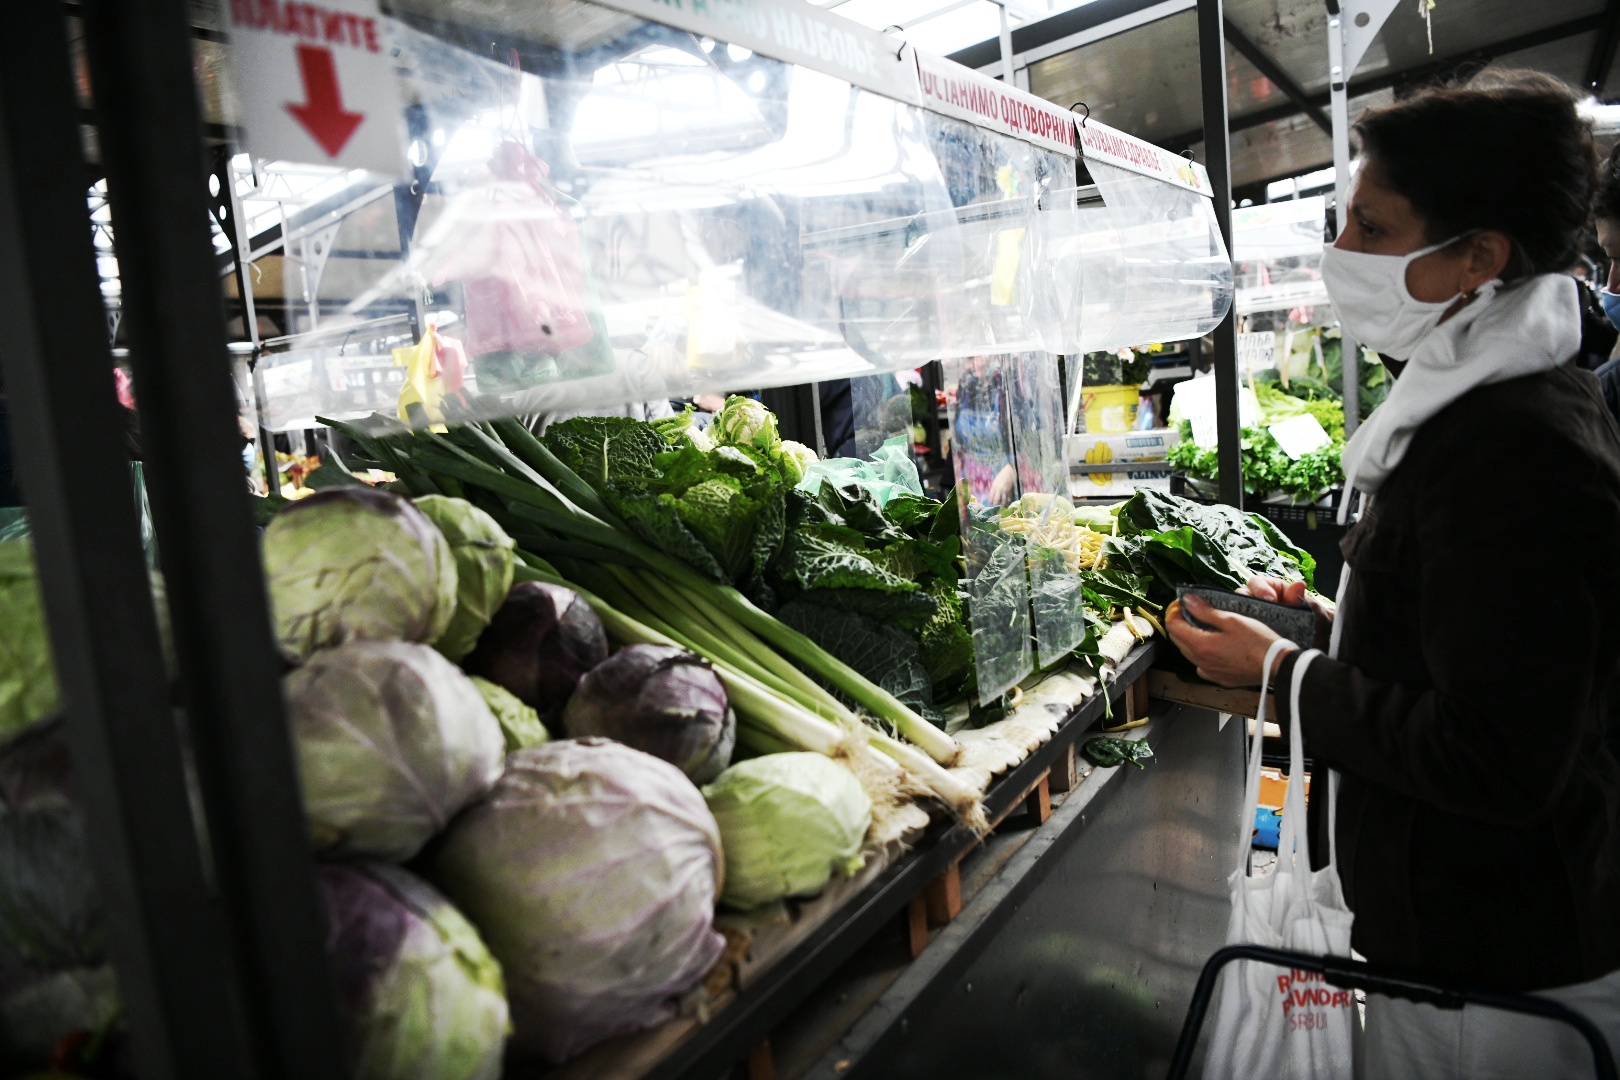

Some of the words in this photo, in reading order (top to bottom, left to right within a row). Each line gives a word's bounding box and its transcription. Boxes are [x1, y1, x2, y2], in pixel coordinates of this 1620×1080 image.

[771, 6, 881, 79] НАЈБОЉЕ
[922, 71, 999, 120] ОСТАНИМО
[1000, 94, 1067, 145] ОДГОВОРНИ
[1078, 121, 1128, 161] САЧУВАЈМО
[1125, 140, 1162, 172] ЗДРАВЉЕ
